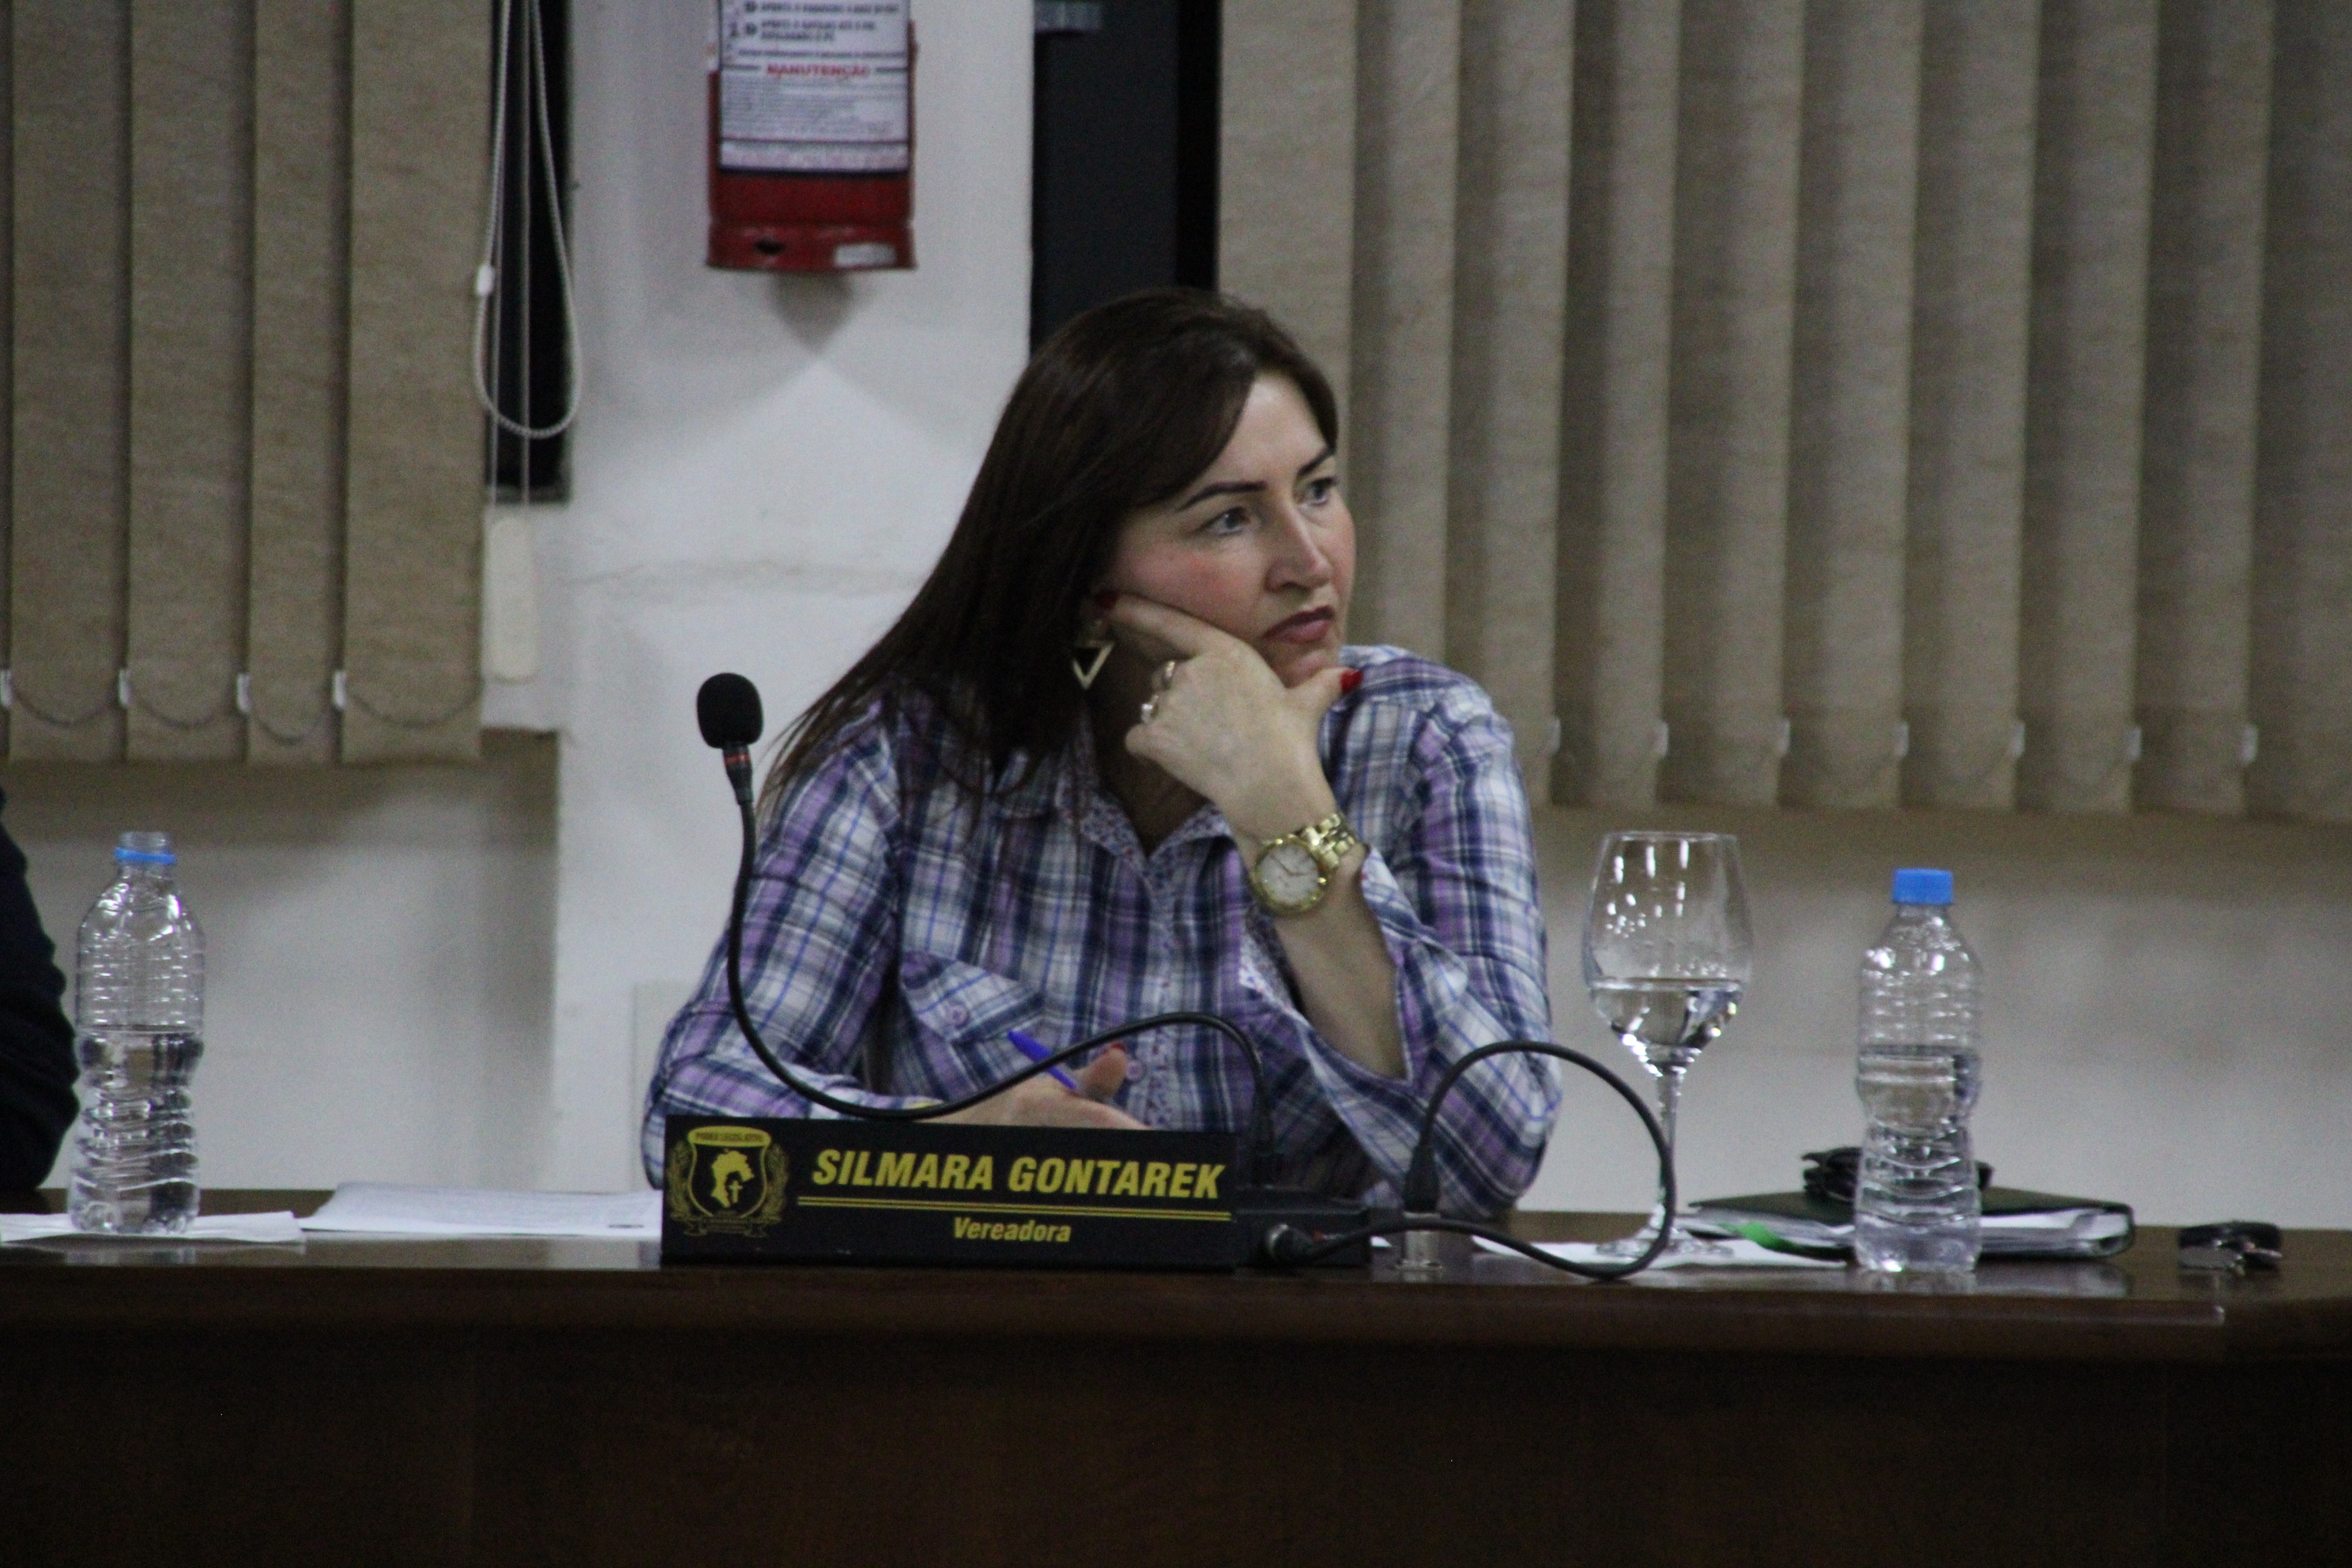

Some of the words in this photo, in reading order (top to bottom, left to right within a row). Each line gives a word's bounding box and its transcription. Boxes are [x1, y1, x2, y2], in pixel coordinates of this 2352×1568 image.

[812, 1148, 993, 1191] SILMARA
[1008, 1156, 1225, 1200] GONTAREK
[953, 1216, 1072, 1243] Vereadora
